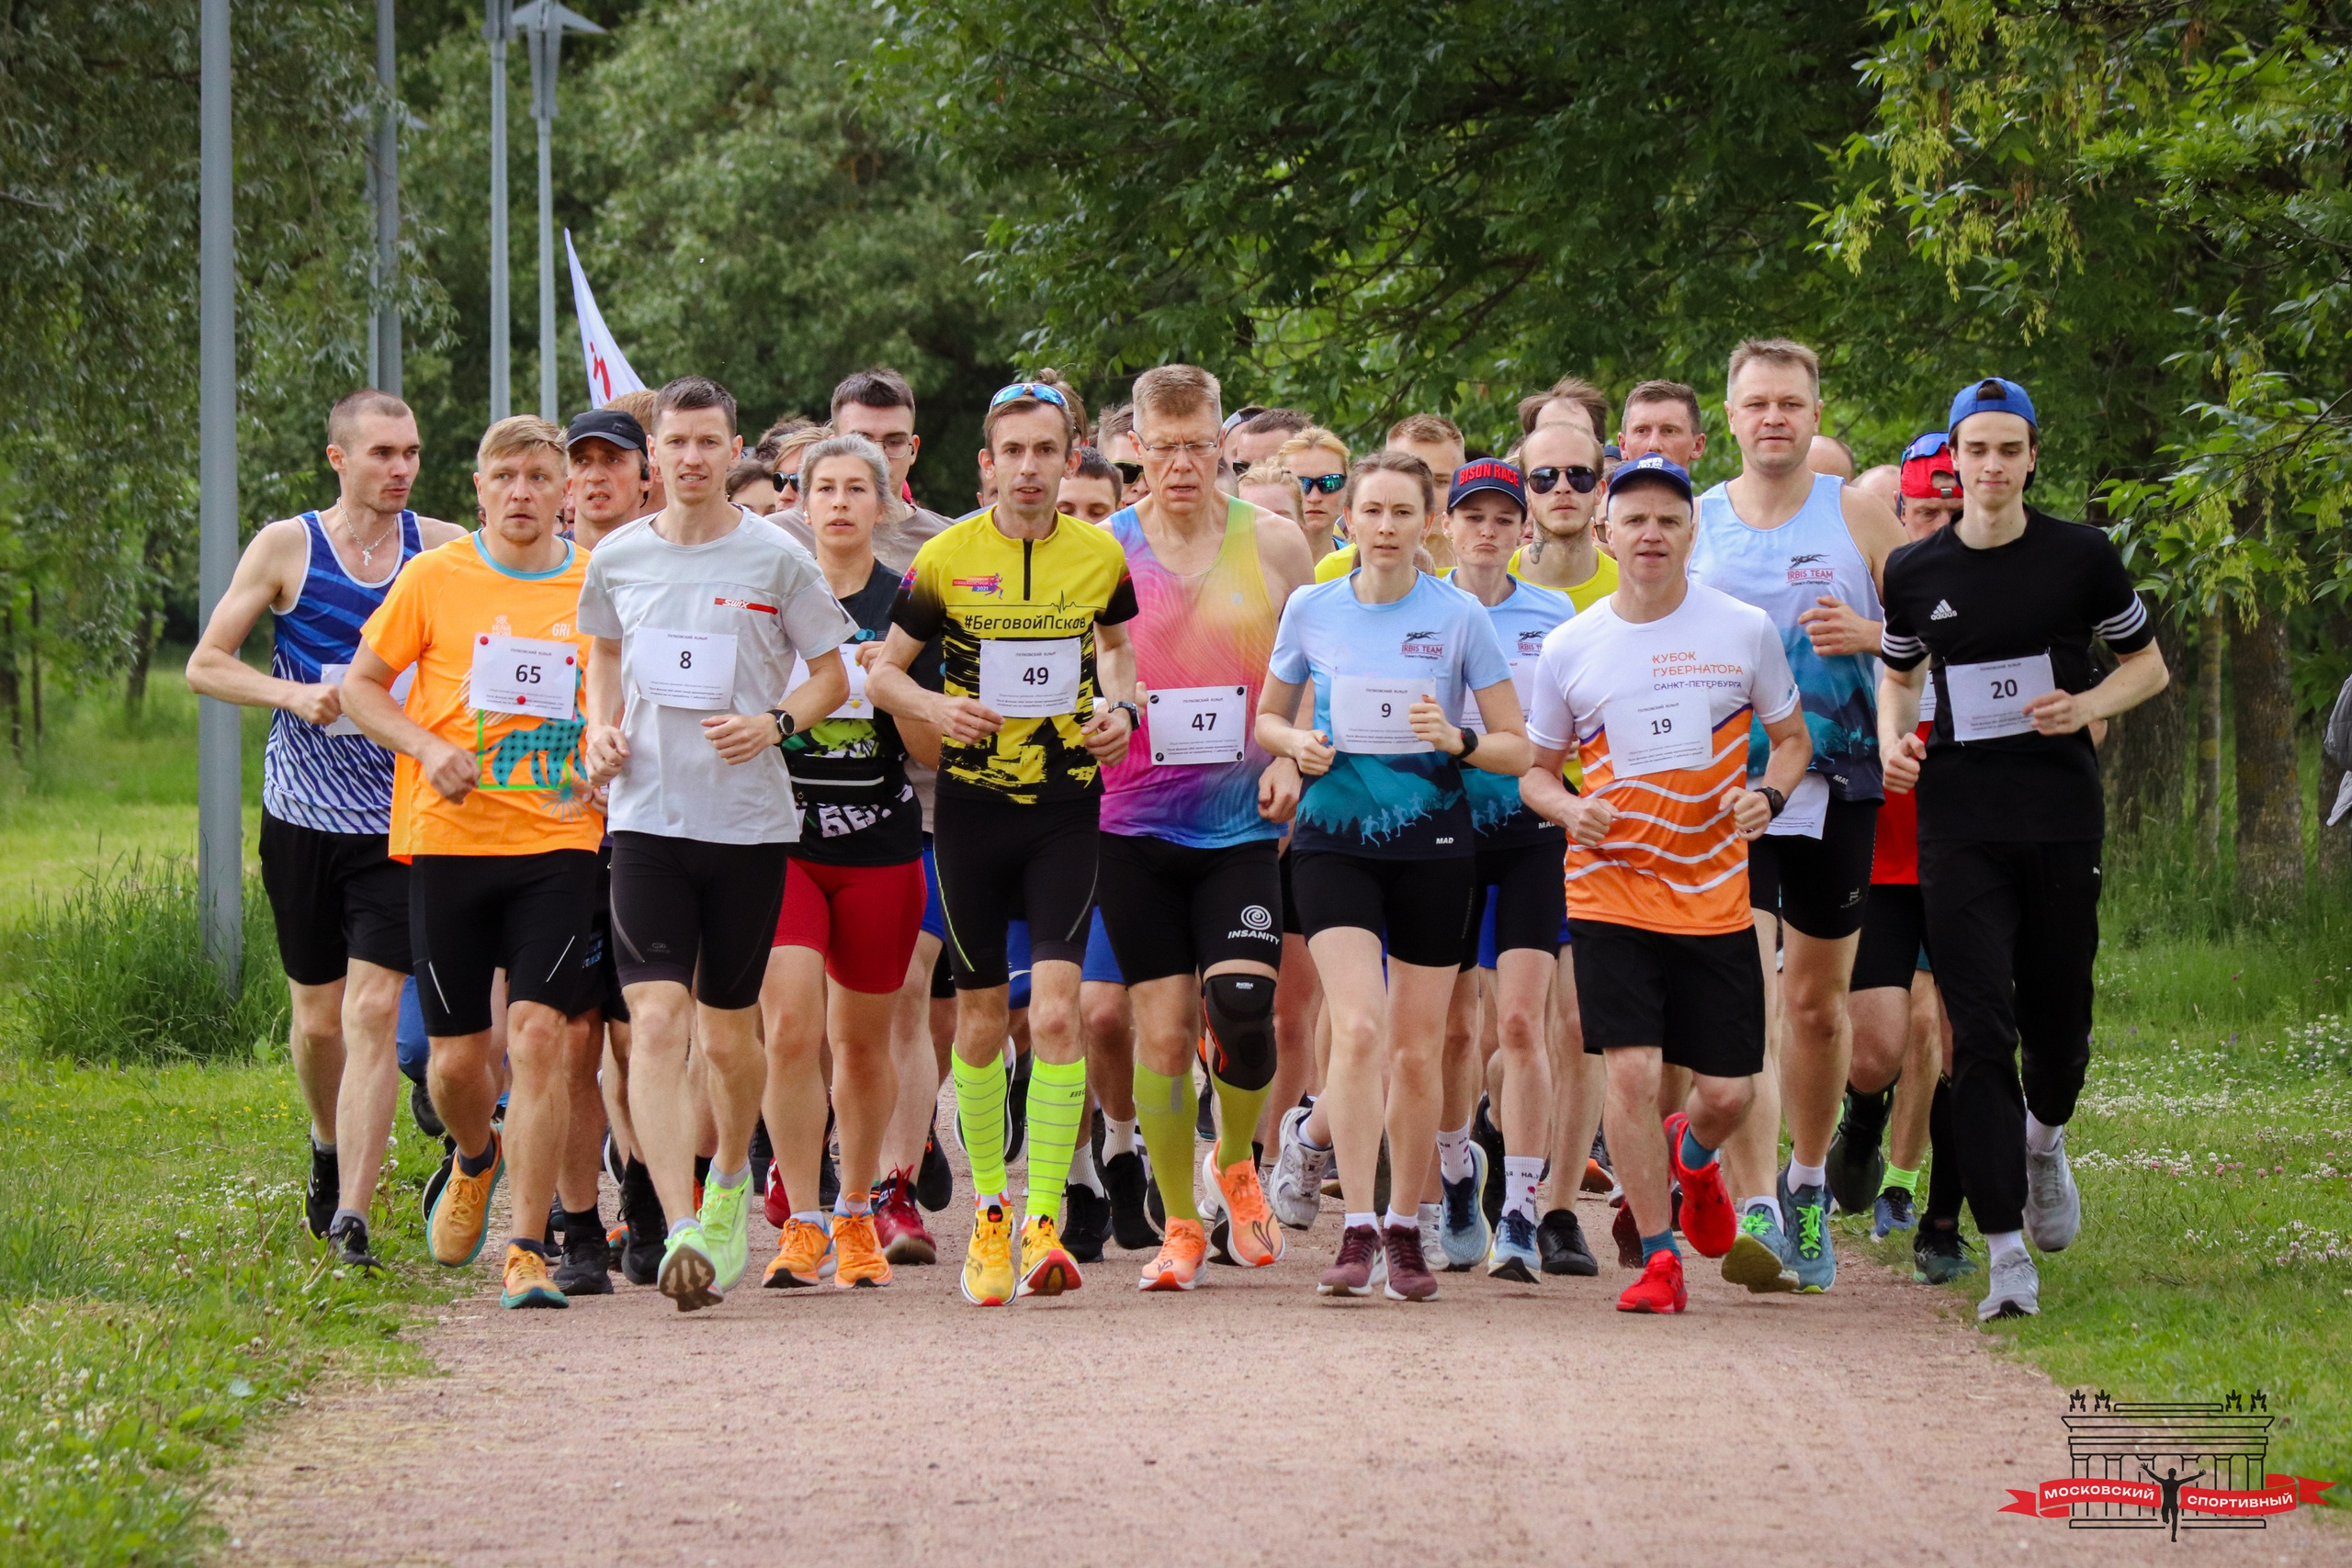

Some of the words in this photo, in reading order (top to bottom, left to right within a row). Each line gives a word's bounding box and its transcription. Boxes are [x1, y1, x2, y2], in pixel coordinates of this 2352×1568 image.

[1459, 463, 1492, 486] BISON
[1494, 464, 1520, 488] RACE
[1788, 570, 1807, 581] IRBIS
[1810, 570, 1833, 580] TEAM
[1930, 610, 1958, 620] adidas
[965, 615, 1086, 630] #БеговойПсков
[1402, 644, 1419, 652] IRBIS
[1422, 645, 1442, 655] TEAM
[1518, 642, 1534, 650] IRBIS
[680, 650, 692, 670] 8
[1652, 651, 1696, 663] КУБОК
[515, 664, 541, 684] 65
[1023, 667, 1049, 685] 49
[1653, 664, 1744, 678] ГУБЕРНАТОРА
[1654, 681, 1742, 691] САНКТ-ПЕТЕРБУРГА
[1990, 679, 2018, 699] 20
[1381, 703, 1392, 717] 9
[1192, 713, 1217, 731] 47
[1651, 718, 1672, 735] 19
[1436, 837, 1454, 845] MAD
[1227, 930, 1280, 945] INSANITY
